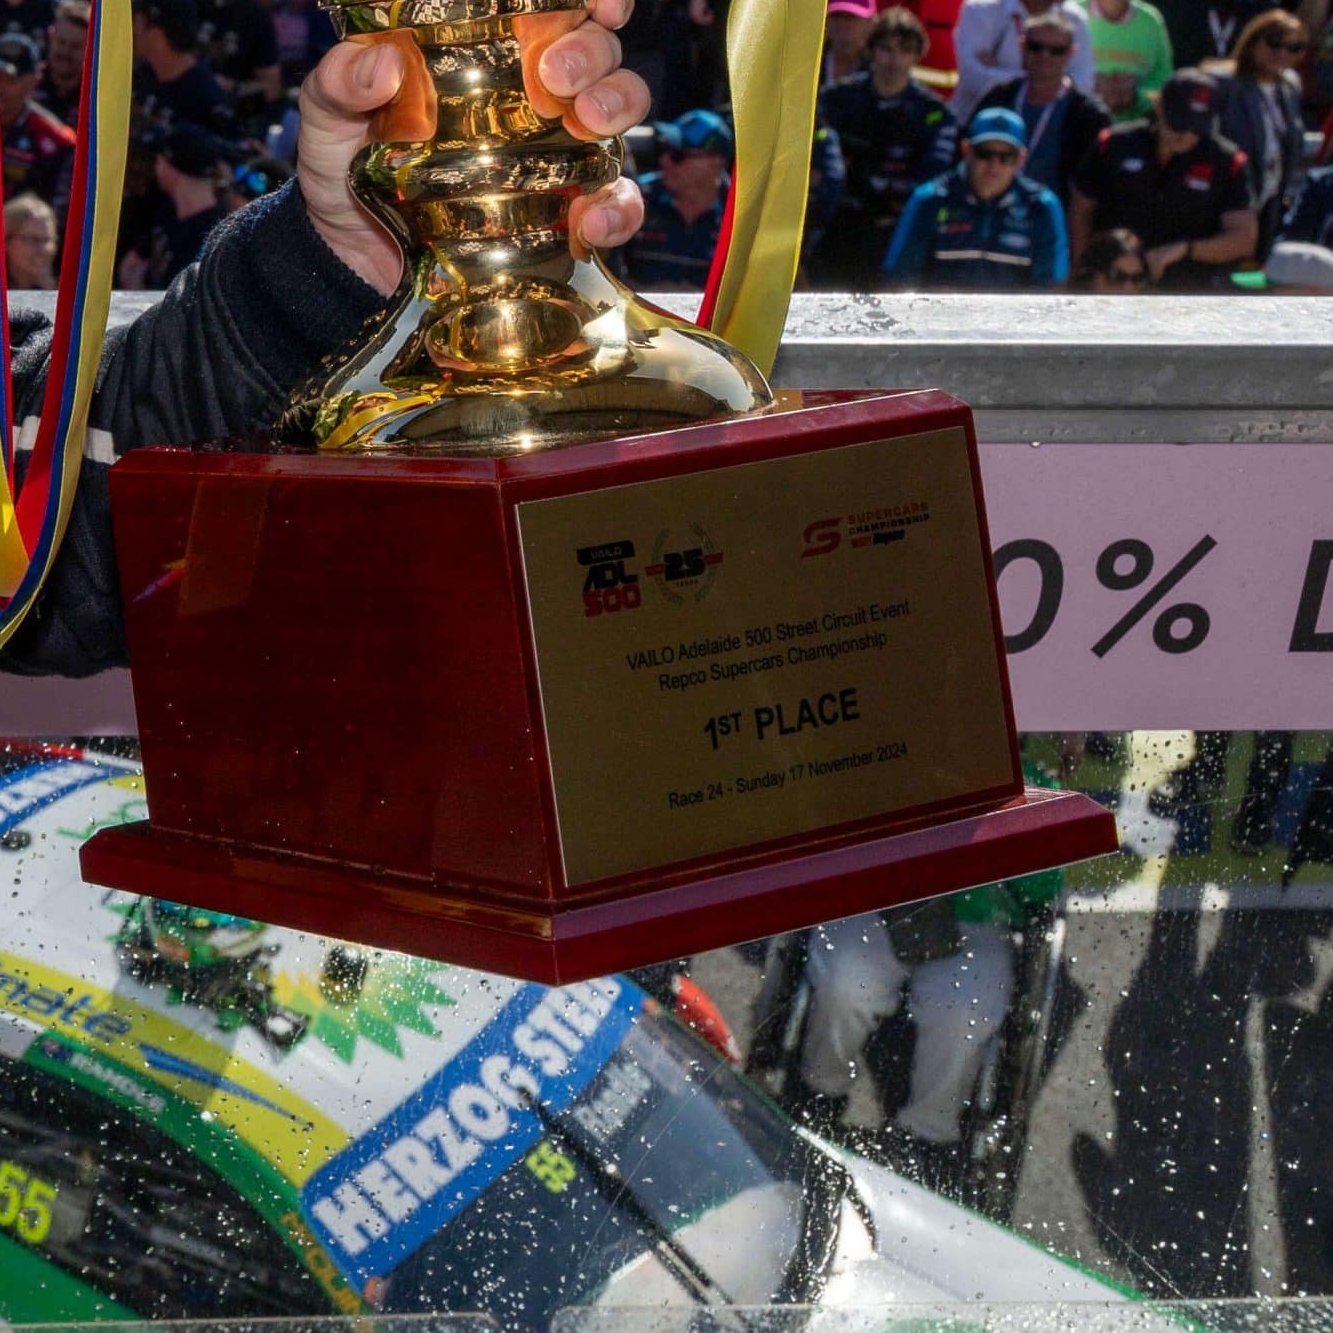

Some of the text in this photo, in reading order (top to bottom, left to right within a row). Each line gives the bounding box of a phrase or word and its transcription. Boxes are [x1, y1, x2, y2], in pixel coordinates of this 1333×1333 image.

[847, 502, 928, 524] SUPERCARS
[849, 512, 930, 535] CHAMPIONSHIP
[664, 548, 706, 582] 25
[582, 584, 642, 618] 500
[626, 600, 910, 671] VAILO Adelaide 500 Street Circuit Event
[659, 631, 888, 692] Repco Supercars Championship
[703, 688, 861, 751] 1ST PLACE
[668, 789, 703, 809] Race
[707, 782, 724, 801] 24
[736, 768, 786, 794] Sunday
[789, 763, 804, 782] 17
[808, 750, 874, 777] November
[877, 742, 908, 763] 2024
[311, 1054, 540, 1256] HERZOG
[525, 1139, 577, 1194] 55
